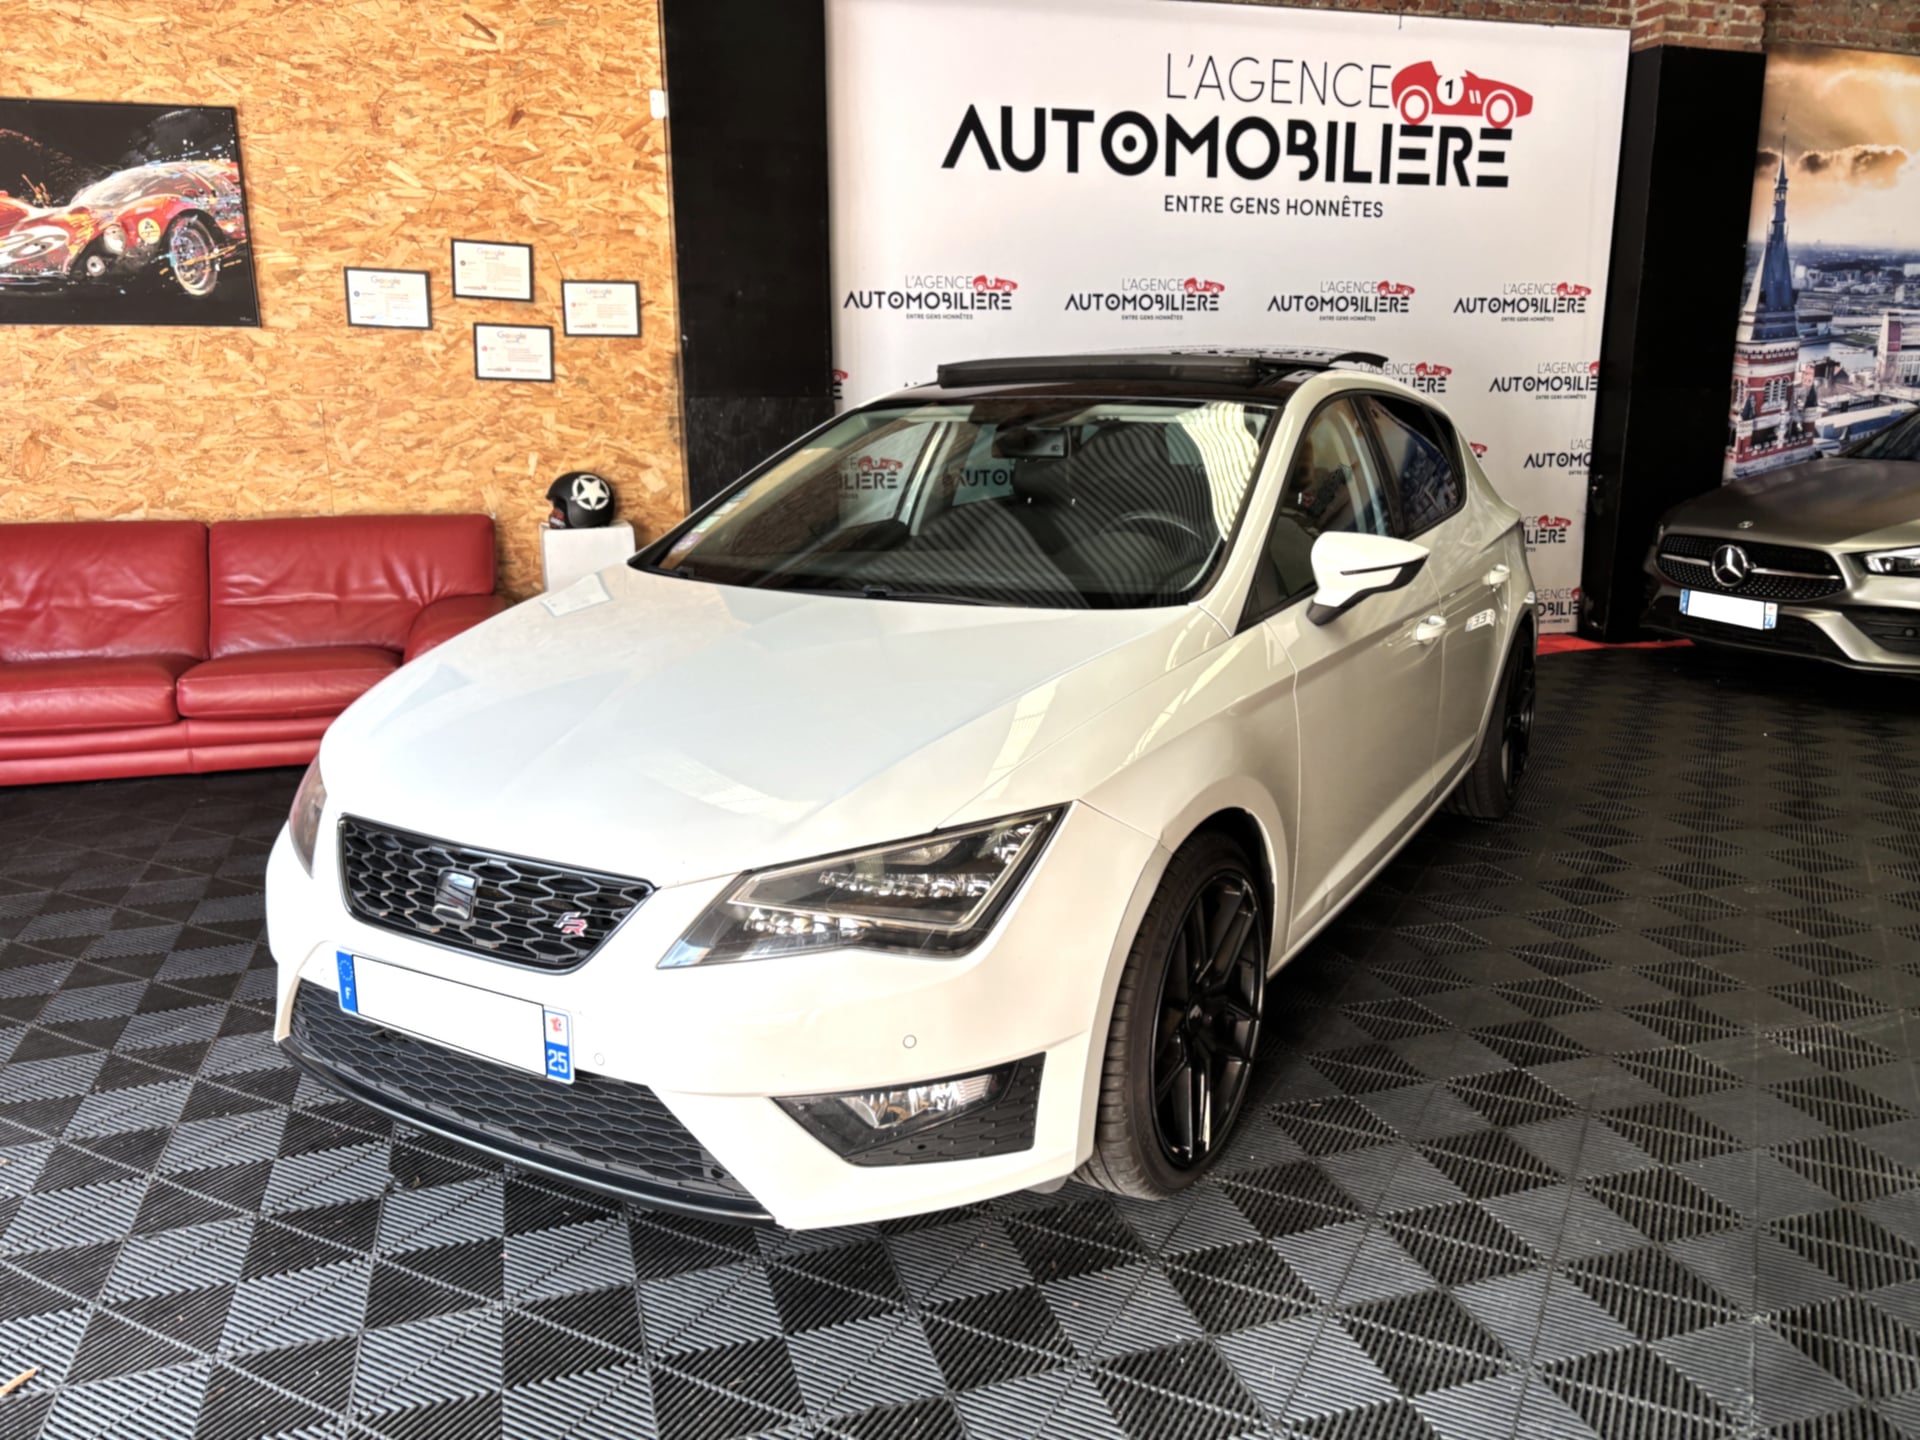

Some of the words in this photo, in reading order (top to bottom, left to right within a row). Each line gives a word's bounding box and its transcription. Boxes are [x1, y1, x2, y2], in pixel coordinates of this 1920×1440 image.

[1166, 53, 1392, 109] L'AGENCE
[941, 103, 1513, 188] AUTOMOBILIERE
[1164, 195, 1225, 213] ENTRE
[1230, 197, 1280, 216] GENS
[1286, 196, 1384, 218] HONNÊTES
[905, 274, 974, 290] L'AGENCE
[1121, 277, 1184, 292] L'AGENCE
[1320, 280, 1378, 294] L'AGENCE
[1503, 282, 1557, 296] L'AGENCE
[844, 290, 1012, 310] AUTOMOBILIERE
[1064, 293, 1220, 311] AUTOMOBILIERE
[1267, 295, 1410, 313] AUTOMOBILIERE
[1453, 297, 1587, 314] AUTOMOBILIERE
[1537, 361, 1589, 375] L'AGENCE
[1489, 376, 1599, 392] AUTOMOBILIE
[1570, 438, 1592, 450] L'AG
[1536, 587, 1571, 600] GENCE
[547, 1049, 568, 1074] 25
